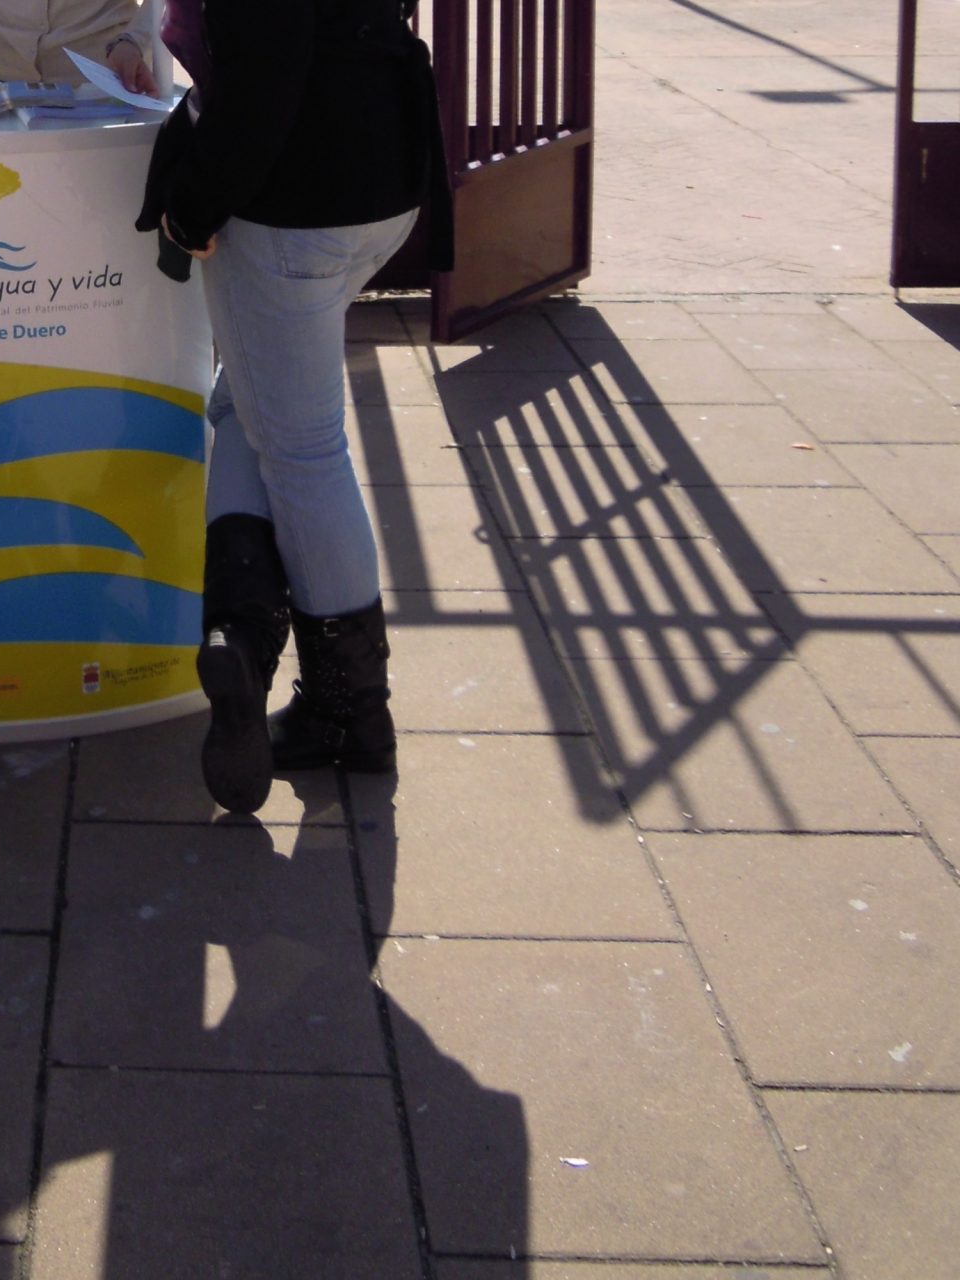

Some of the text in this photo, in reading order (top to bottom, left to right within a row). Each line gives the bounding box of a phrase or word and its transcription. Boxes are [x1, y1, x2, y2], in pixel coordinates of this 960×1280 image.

[48, 277, 63, 302] y
[72, 264, 123, 291] vida
[15, 304, 31, 315] del
[35, 301, 89, 313] Patrimonio
[93, 298, 124, 309] Fluvial
[12, 324, 67, 340] Duero
